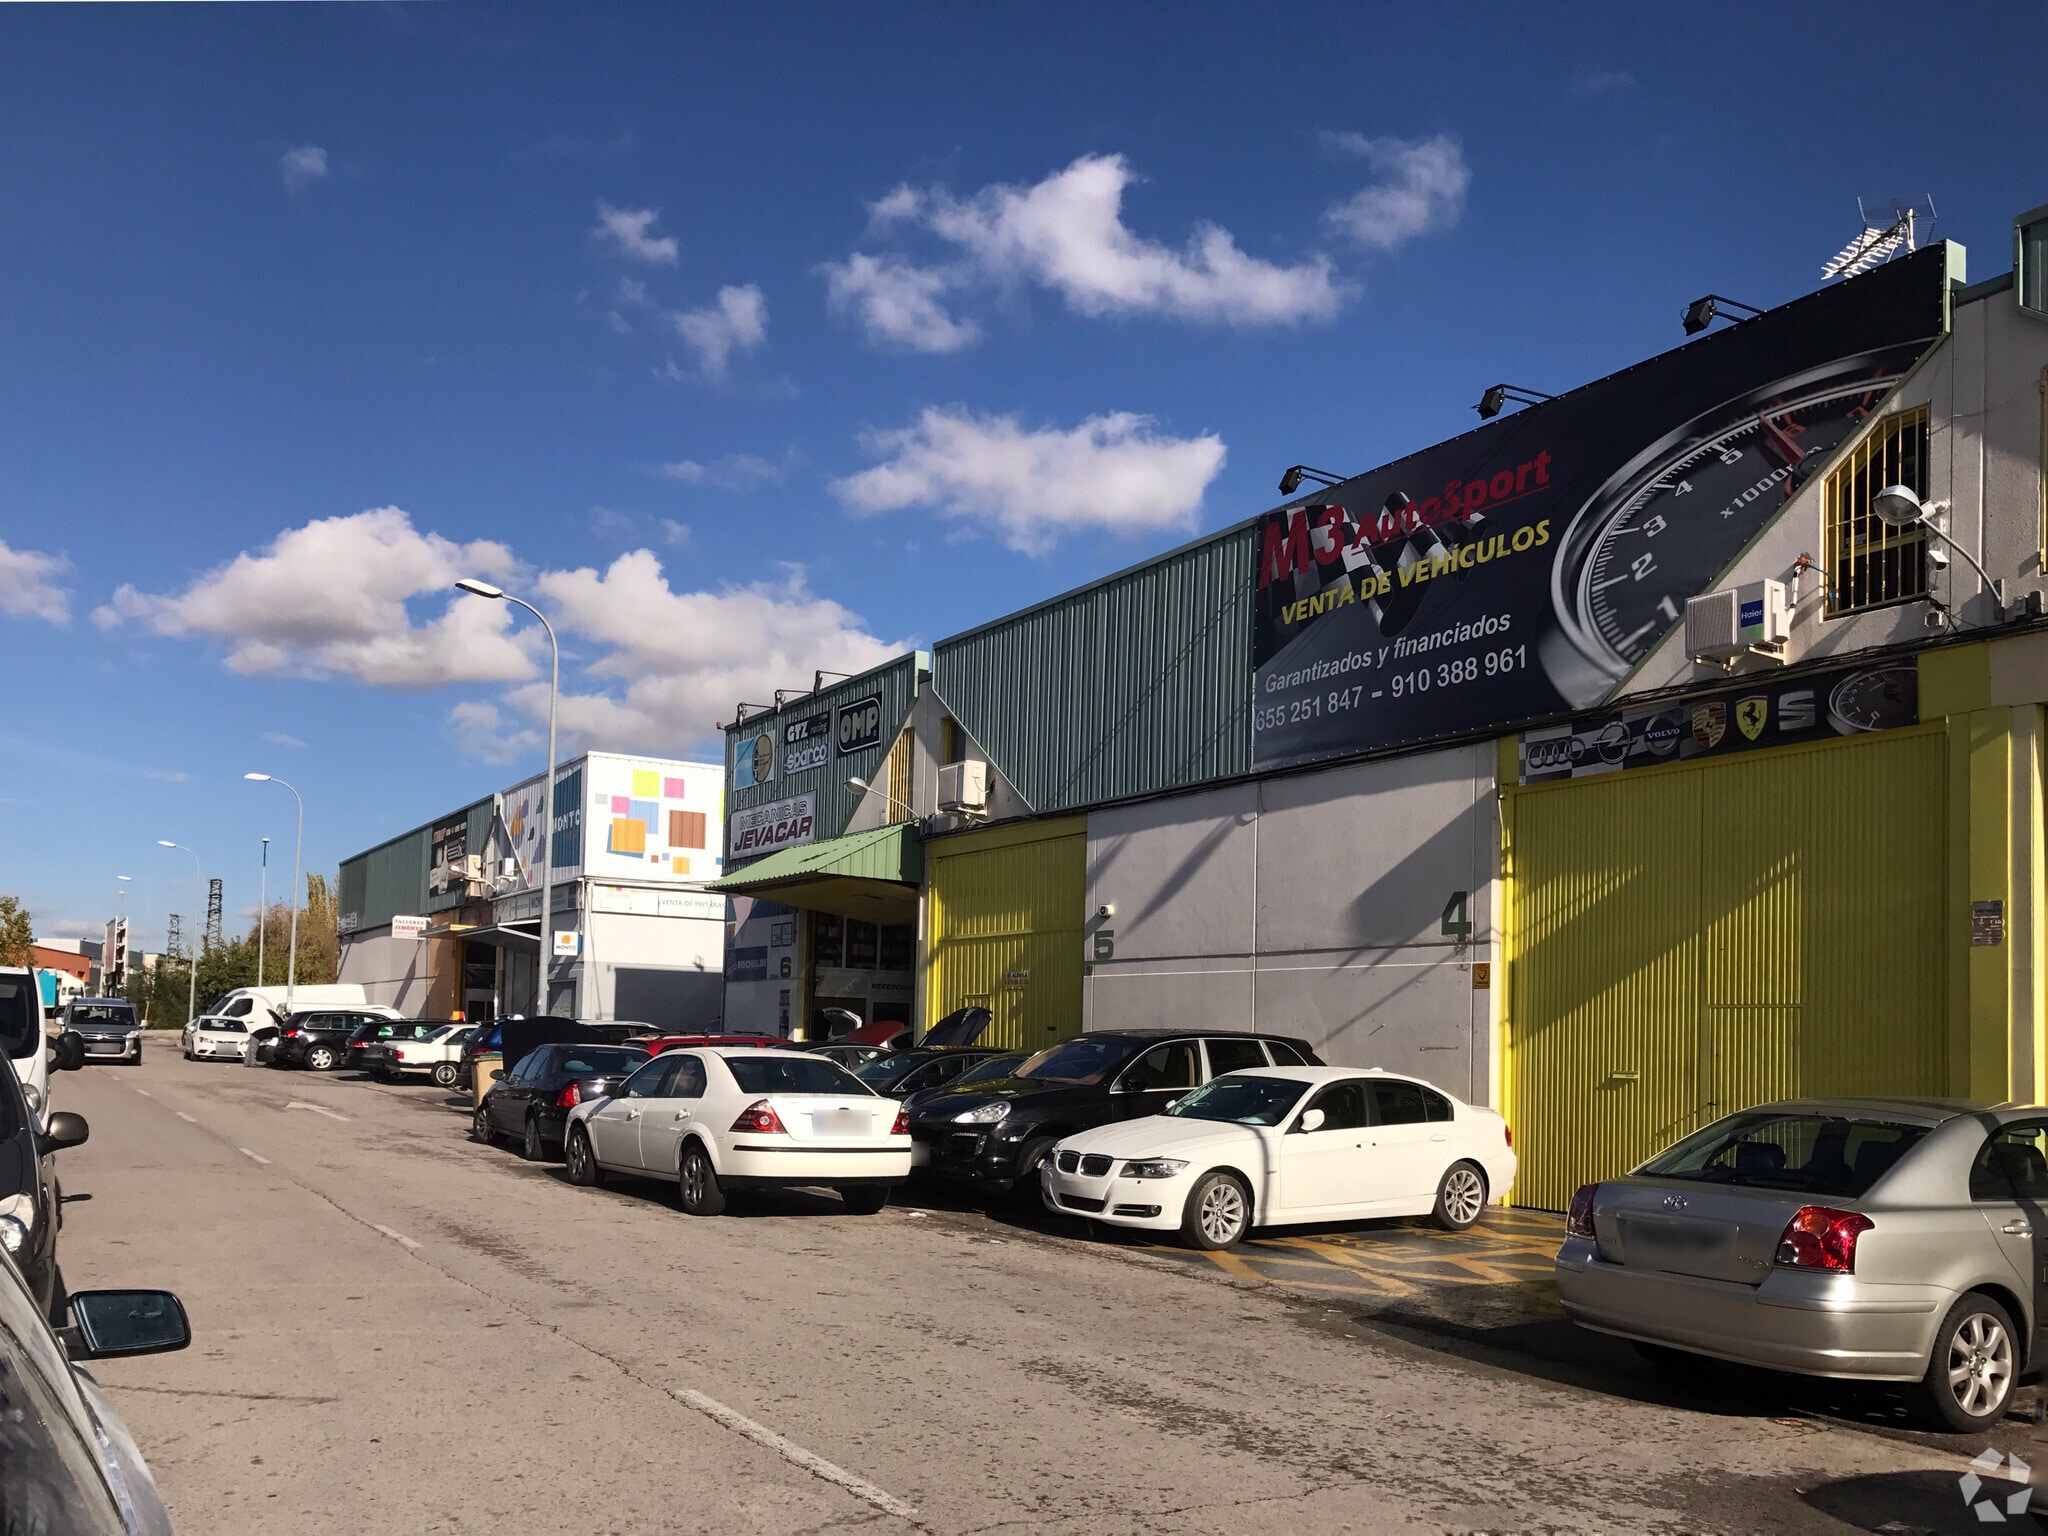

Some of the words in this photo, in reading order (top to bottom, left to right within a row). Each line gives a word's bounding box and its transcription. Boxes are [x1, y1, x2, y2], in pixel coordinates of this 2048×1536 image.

[1720, 447, 1743, 465] 5
[1351, 450, 1551, 549] AutoSport
[1674, 480, 1694, 497] 4
[1642, 514, 1667, 538] 3
[1281, 584, 1355, 625] VENTA
[1361, 570, 1391, 601] DE
[1398, 519, 1550, 588] VEHÍCULOS
[1631, 552, 1657, 582] 2
[1657, 595, 1679, 621] 1
[1741, 608, 1763, 621] Haier
[1265, 647, 1372, 694] Garantizados
[1376, 646, 1389, 669] y
[1393, 611, 1511, 659] financiados
[1256, 705, 1286, 732] 655
[1290, 696, 1321, 722] 251
[1327, 686, 1363, 713] 847
[1391, 668, 1431, 697] 910
[1437, 656, 1478, 688] 388
[1484, 644, 1526, 677] 961
[787, 721, 808, 742] GTZ
[840, 706, 879, 743] OMP
[1647, 727, 1680, 739] VOLVO
[785, 744, 827, 770] sparco
[740, 801, 807, 830] MECANICAS
[734, 816, 812, 851] JEVACAR
[661, 899, 682, 907] VENTA
[1441, 891, 1472, 941] 4
[1094, 930, 1114, 961] 5
[737, 959, 767, 969] MICHELIN
[780, 957, 791, 978] 6
